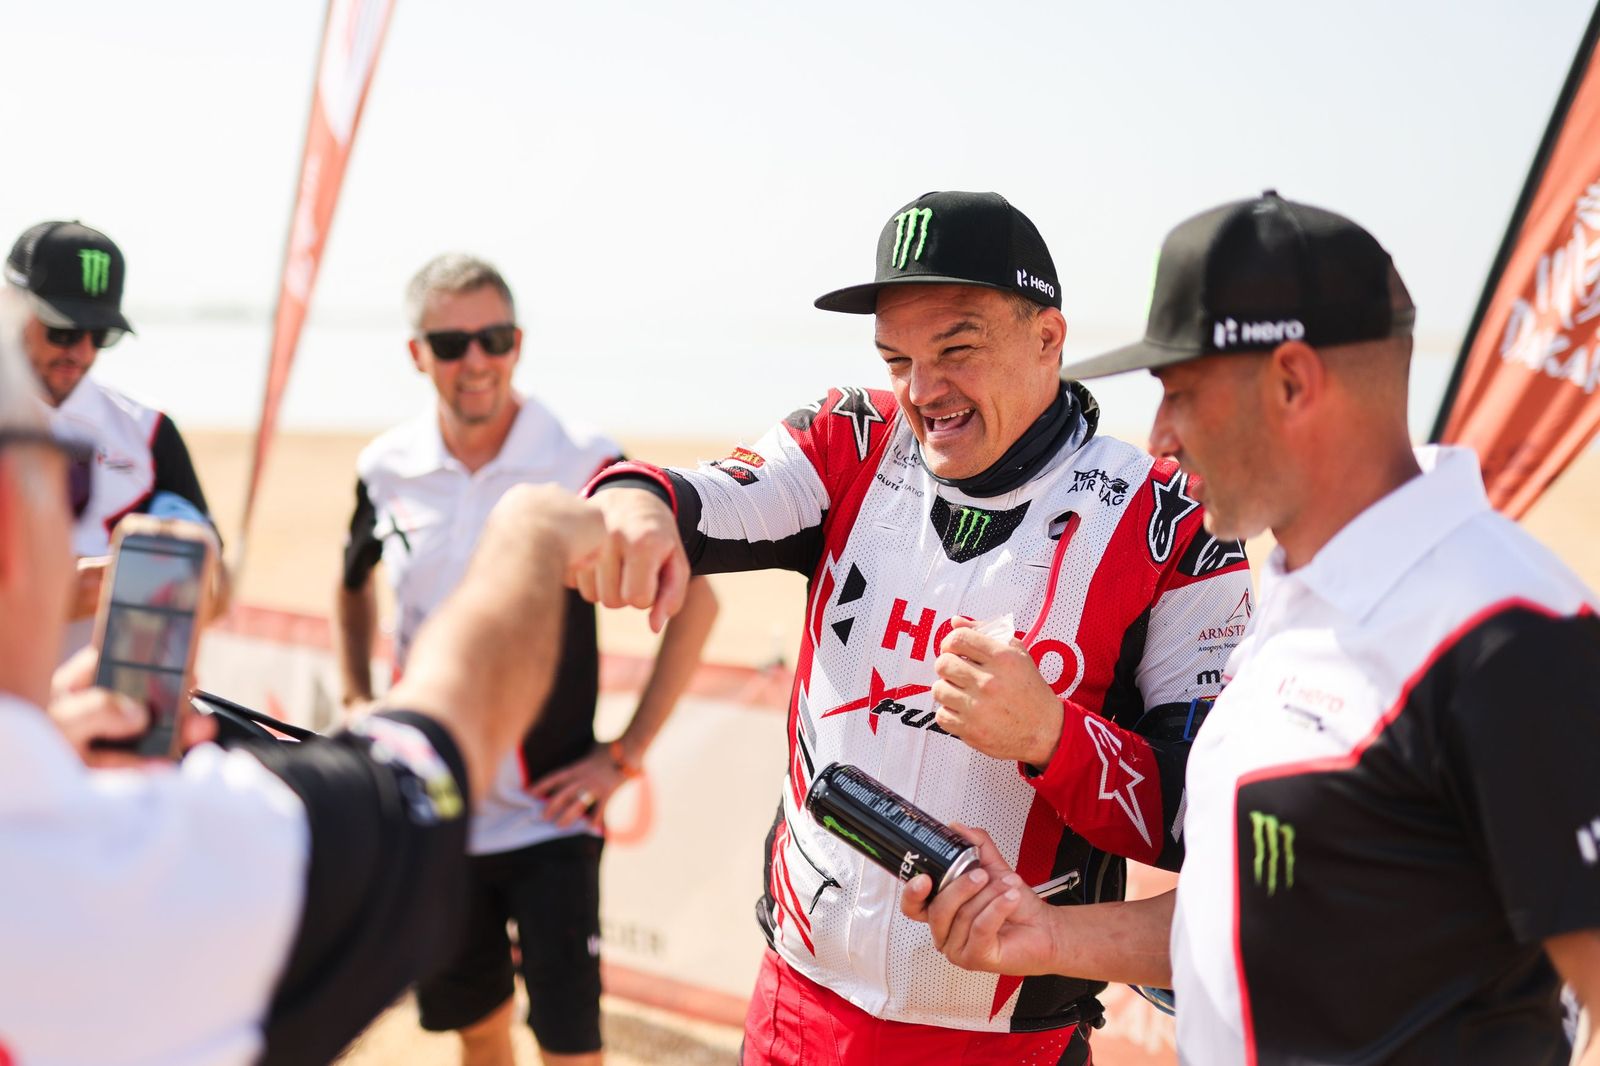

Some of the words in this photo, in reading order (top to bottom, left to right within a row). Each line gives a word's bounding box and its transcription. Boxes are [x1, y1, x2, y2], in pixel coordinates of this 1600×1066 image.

[1030, 275, 1055, 298] Hero
[1241, 319, 1305, 343] Hero
[1074, 468, 1106, 481] TECH
[1067, 479, 1096, 493] AIR
